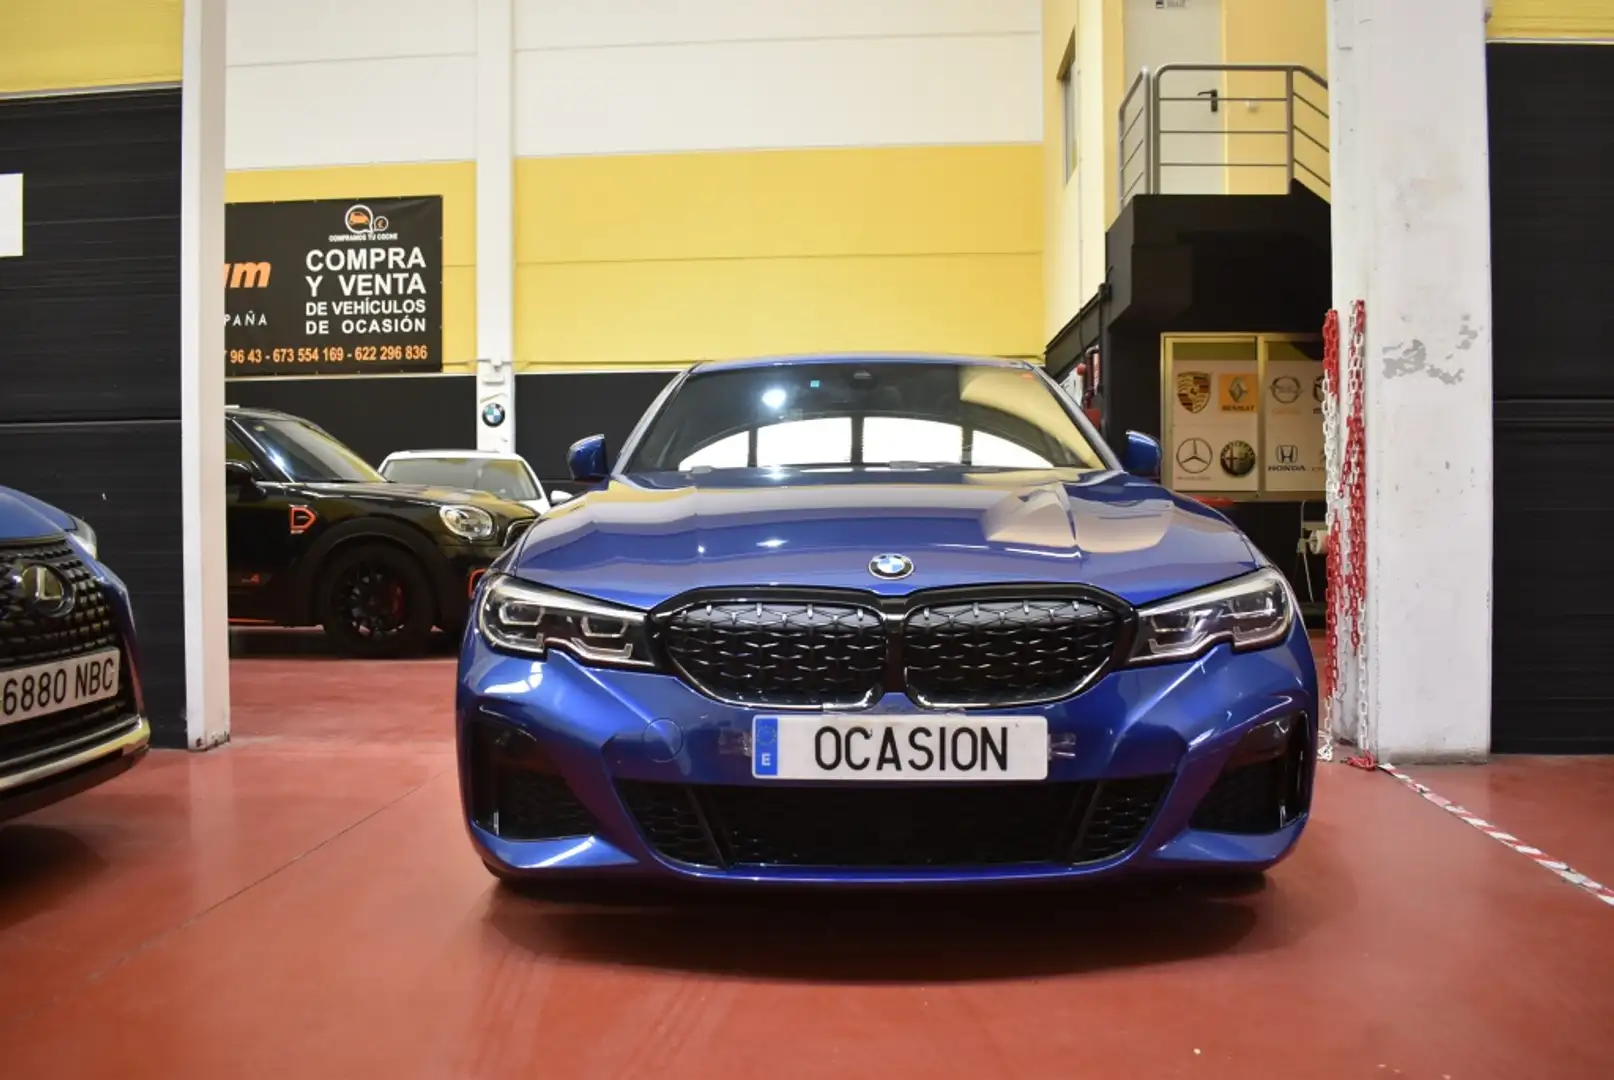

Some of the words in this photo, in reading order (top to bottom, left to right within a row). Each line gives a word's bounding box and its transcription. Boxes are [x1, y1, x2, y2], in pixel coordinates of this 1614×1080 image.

[305, 246, 426, 272] COMPRA
[305, 275, 324, 297] Y
[338, 272, 426, 297] VENTA
[305, 301, 328, 316] DE
[331, 297, 426, 315] VEHÍCULOS
[305, 320, 329, 335] DE
[341, 314, 426, 334] OCASIÓN
[230, 348, 245, 364] 96
[248, 348, 262, 364] 43
[273, 348, 294, 363] 673
[297, 347, 319, 362] 554
[322, 346, 344, 362] 169
[354, 346, 377, 361] 622
[380, 345, 402, 361] 296
[405, 344, 428, 360] 836
[3, 668, 67, 716] 6880
[75, 657, 114, 699] NBC
[761, 753, 771, 766] E
[814, 725, 1008, 772] OCASION
